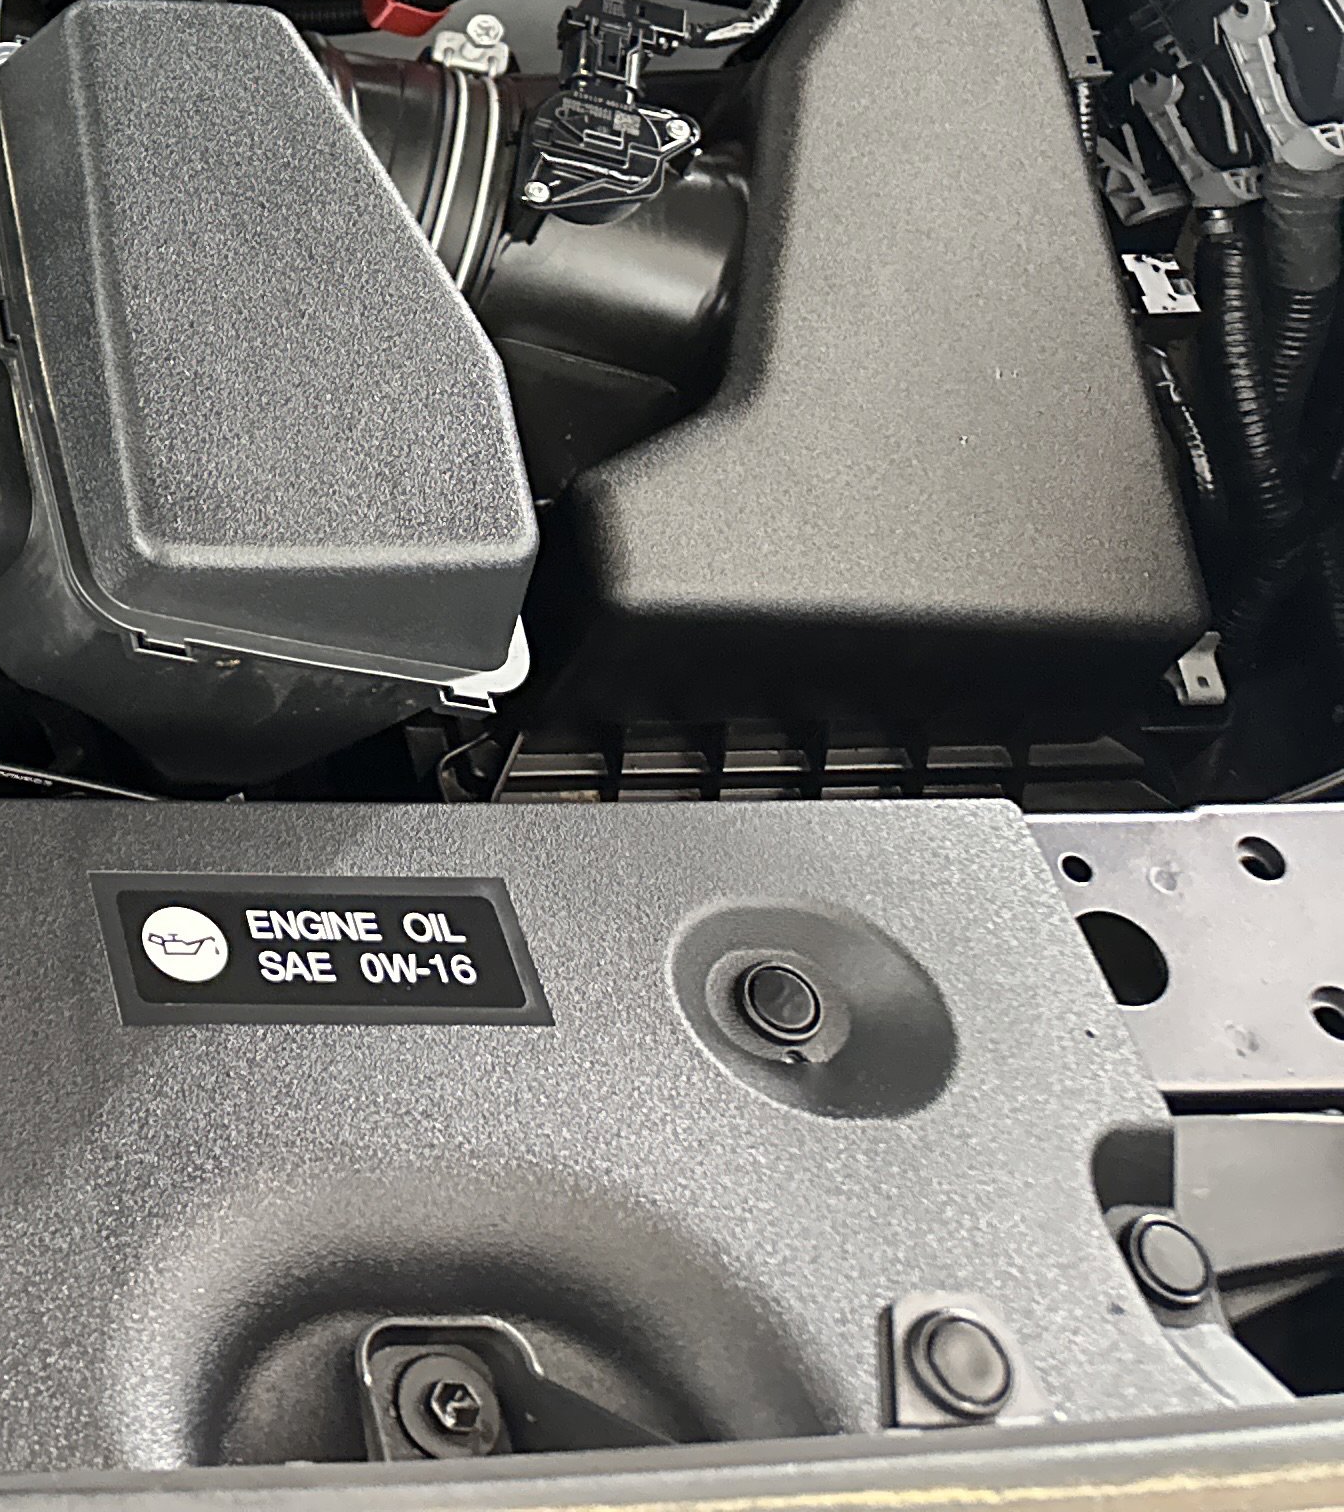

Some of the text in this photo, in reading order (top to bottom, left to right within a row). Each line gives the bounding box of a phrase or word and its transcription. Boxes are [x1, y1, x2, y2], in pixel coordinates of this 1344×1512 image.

[245, 909, 467, 944] ENGINE OIL
[259, 951, 478, 986] SAE 0W-16
